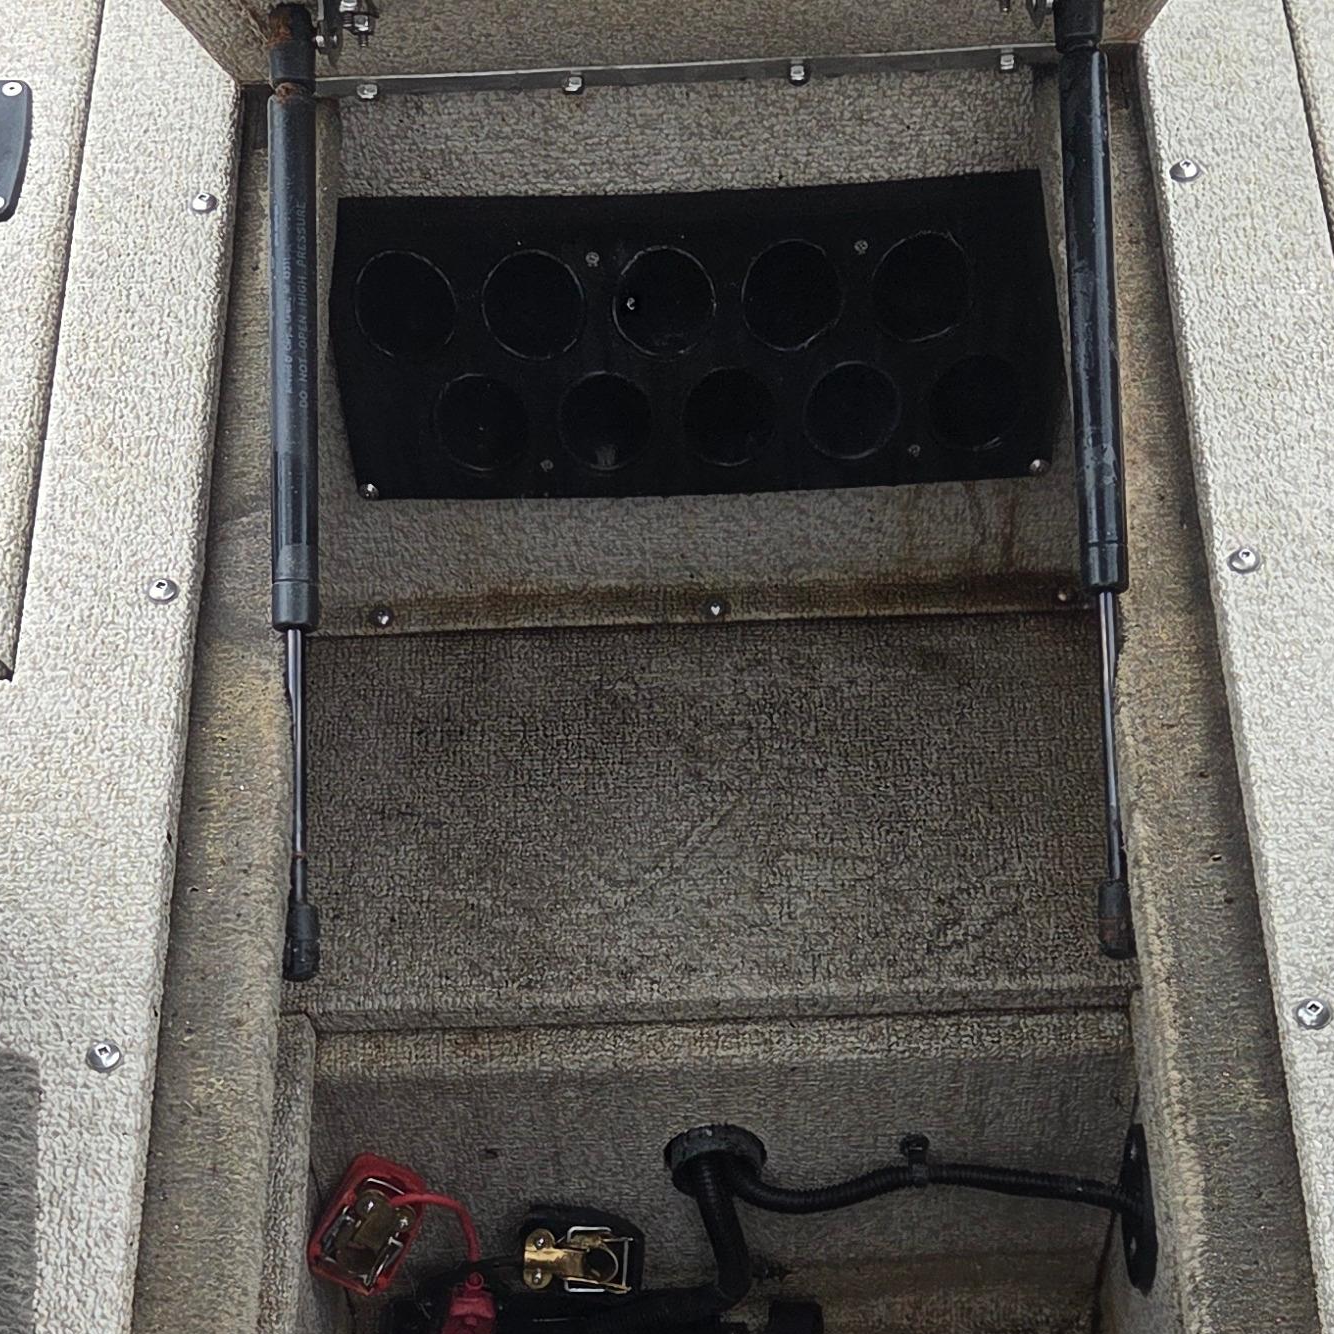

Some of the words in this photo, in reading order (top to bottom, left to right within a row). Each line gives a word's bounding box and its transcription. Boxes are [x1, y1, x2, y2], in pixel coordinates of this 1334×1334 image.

[295, 200, 307, 268] PRESSURE
[296, 275, 308, 307] HIGH
[297, 314, 308, 347] OPEN
[298, 357, 308, 382] NOT
[298, 390, 308, 409] DO
